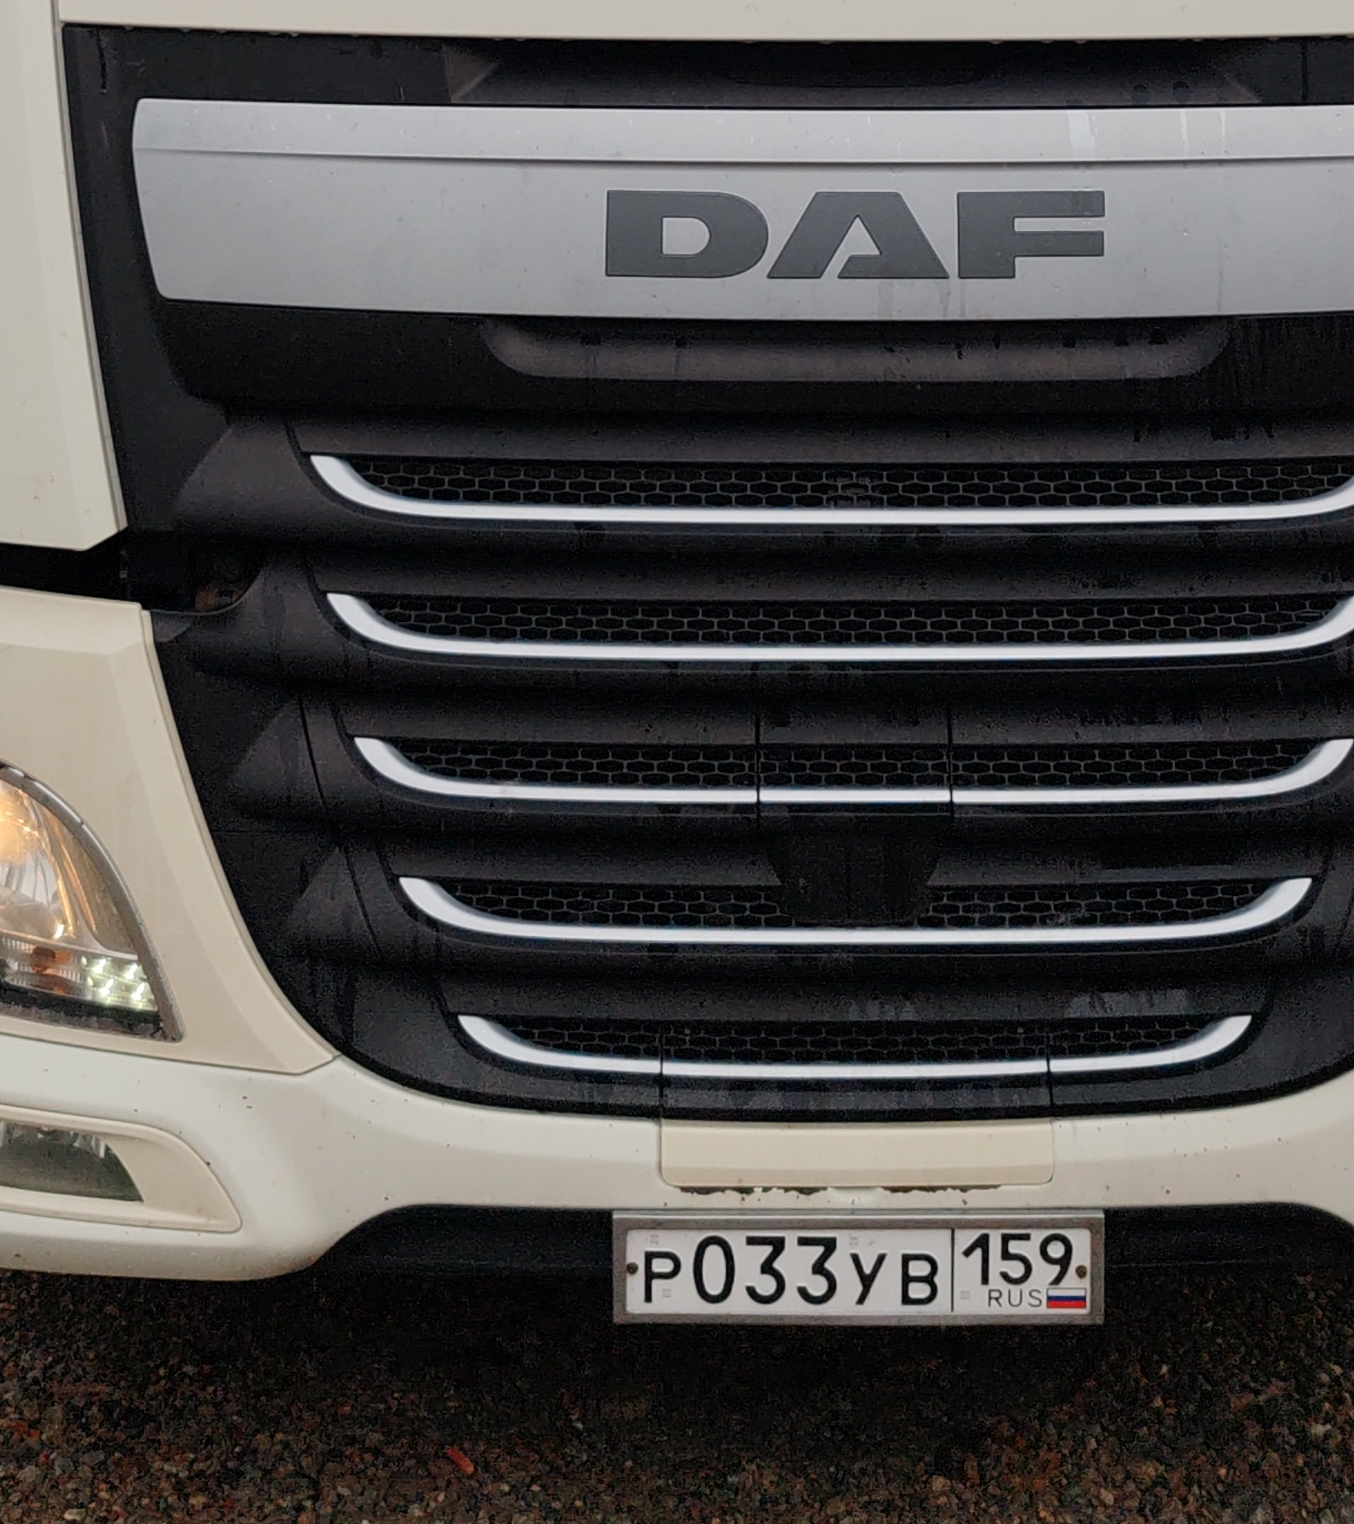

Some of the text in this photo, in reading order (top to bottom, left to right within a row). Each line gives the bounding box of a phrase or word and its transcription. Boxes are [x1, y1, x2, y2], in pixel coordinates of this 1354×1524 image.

[605, 189, 1106, 280] DAF
[961, 1232, 1074, 1286] 159
[986, 1288, 1043, 1309] RUS
